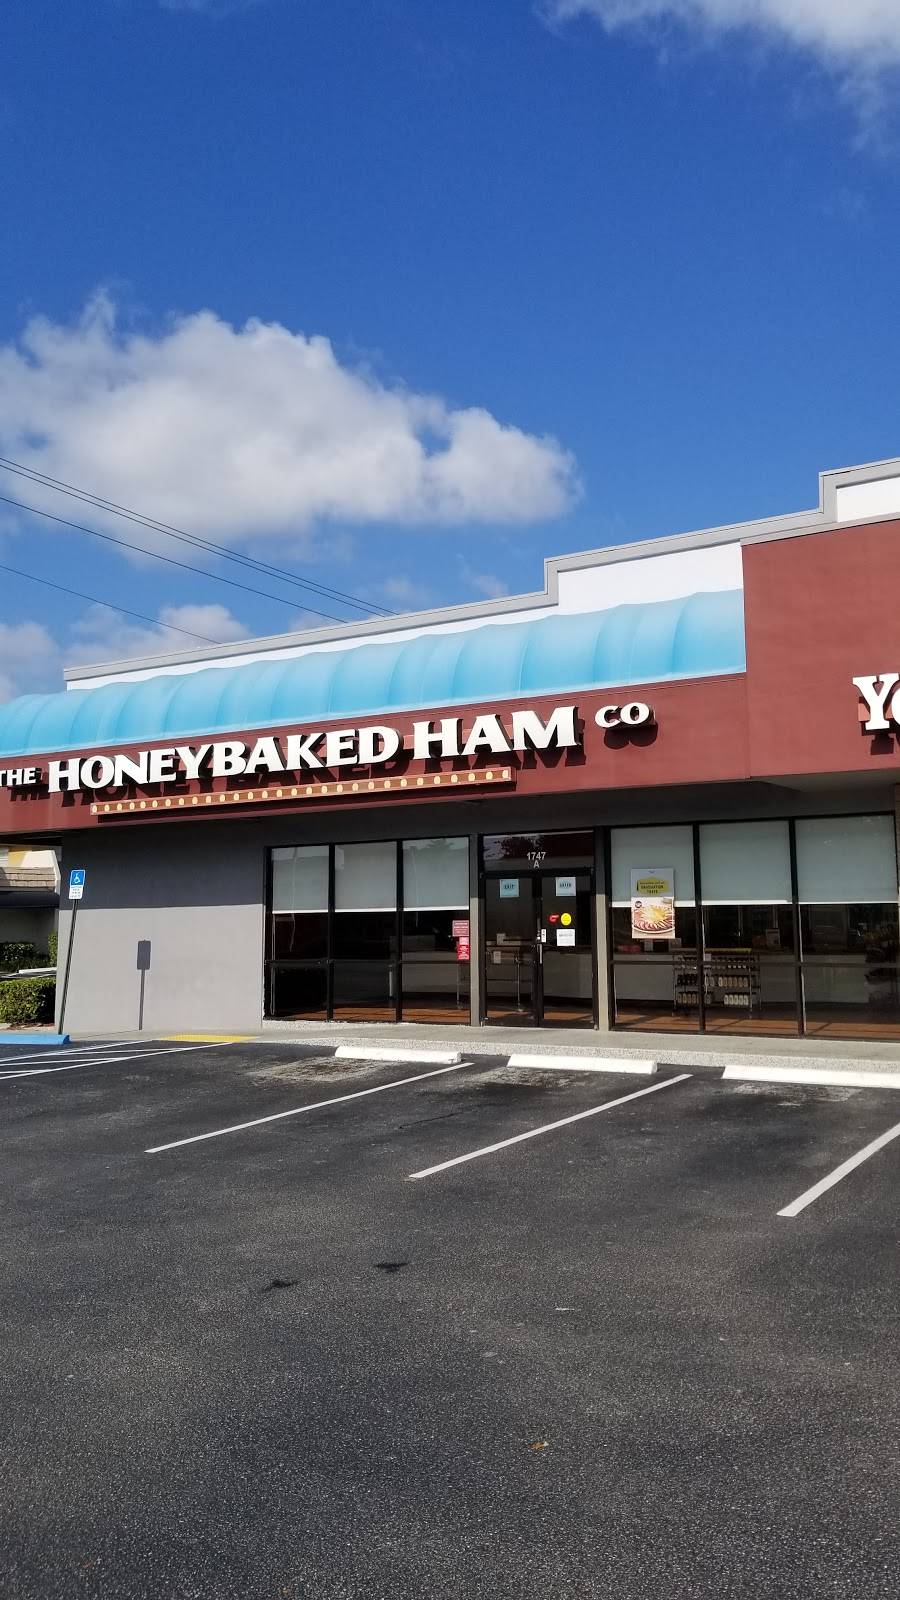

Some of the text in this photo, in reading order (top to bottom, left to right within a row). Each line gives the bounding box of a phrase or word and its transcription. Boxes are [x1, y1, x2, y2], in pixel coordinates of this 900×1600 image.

[0, 702, 650, 793] THE HONEYBAKED HAM CO
[526, 851, 547, 861] 1747
[533, 860, 540, 869] A
